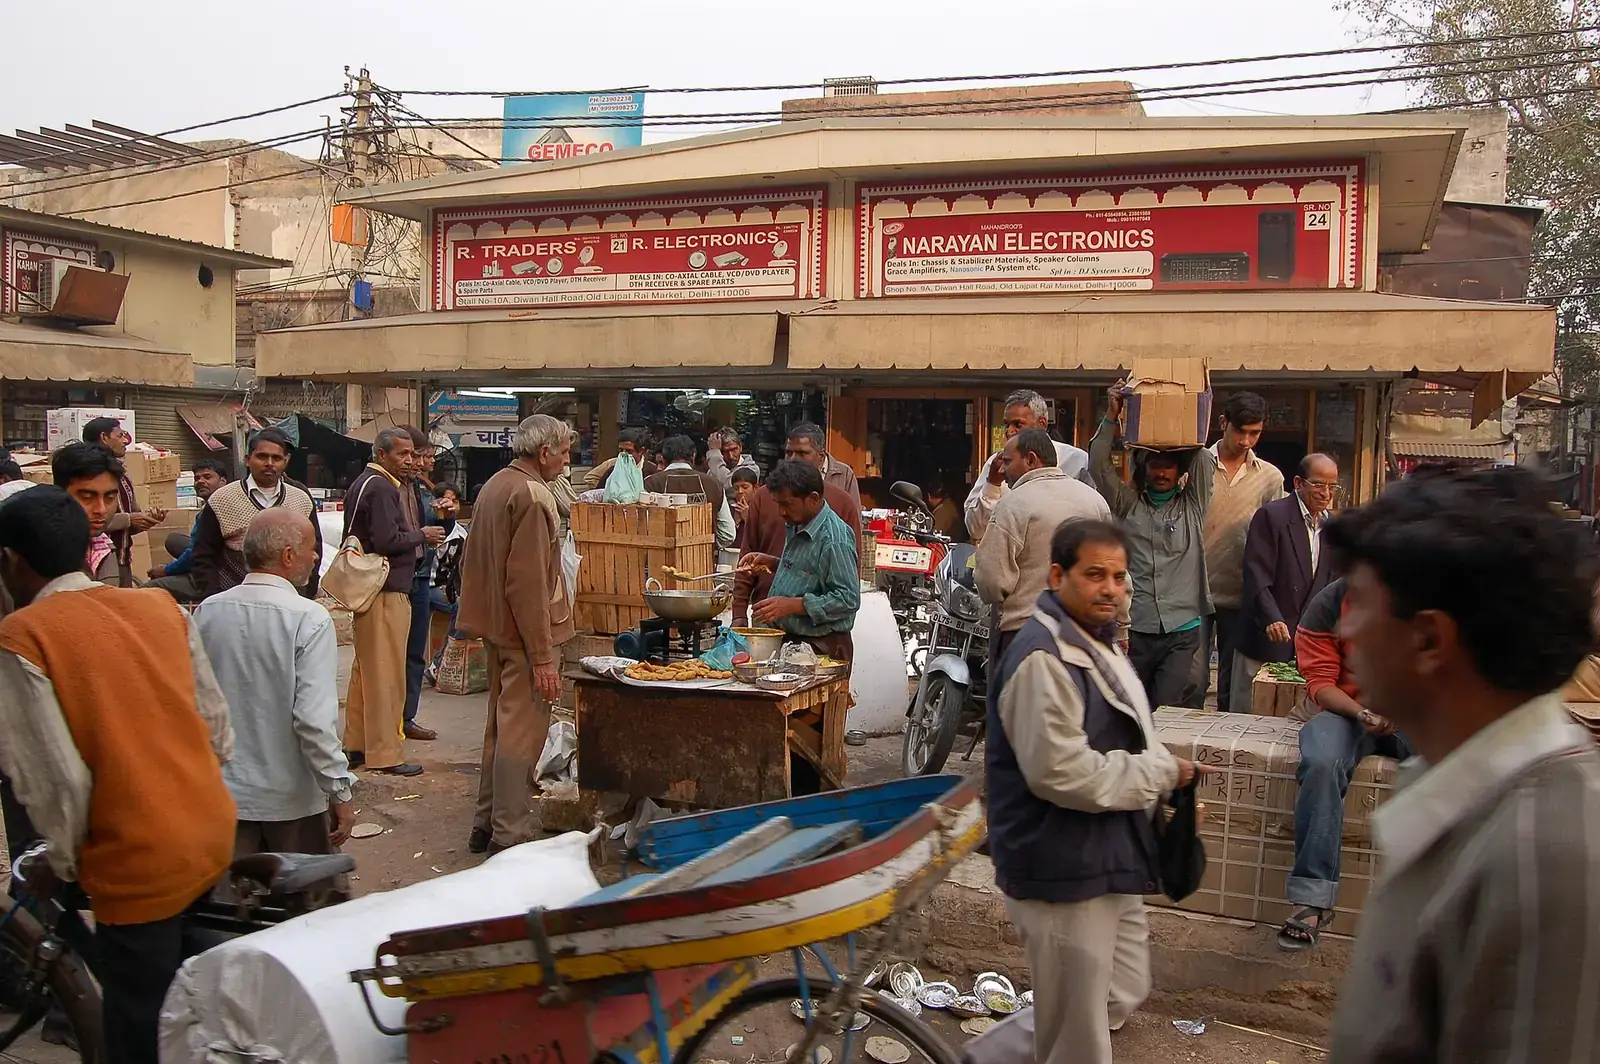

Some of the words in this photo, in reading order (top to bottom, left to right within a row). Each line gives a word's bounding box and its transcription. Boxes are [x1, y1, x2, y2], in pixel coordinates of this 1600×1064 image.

[1308, 214, 1327, 226] 24
[613, 240, 625, 250] 21
[632, 238, 648, 250] R.
[654, 232, 779, 250] ELECTRONICS
[902, 234, 998, 254] NARAYAN
[1004, 229, 1154, 251] ELECTRONICS
[457, 246, 474, 259] R.
[481, 242, 576, 258] TRADERS
[958, 257, 992, 265] Stabilizer
[995, 256, 1031, 264] Materials,
[909, 266, 948, 275] Amplifiers,
[997, 265, 1024, 273] System
[1136, 266, 1151, 274] Ups
[522, 278, 549, 286] VCD/DVD
[550, 277, 569, 286] Player,
[542, 295, 560, 303] Hall
[604, 291, 631, 300] Lajpat
[633, 291, 650, 299] Rai
[652, 290, 685, 299] Market,
[688, 288, 750, 298] Delhi-110006
[476, 426, 516, 448] चाई
